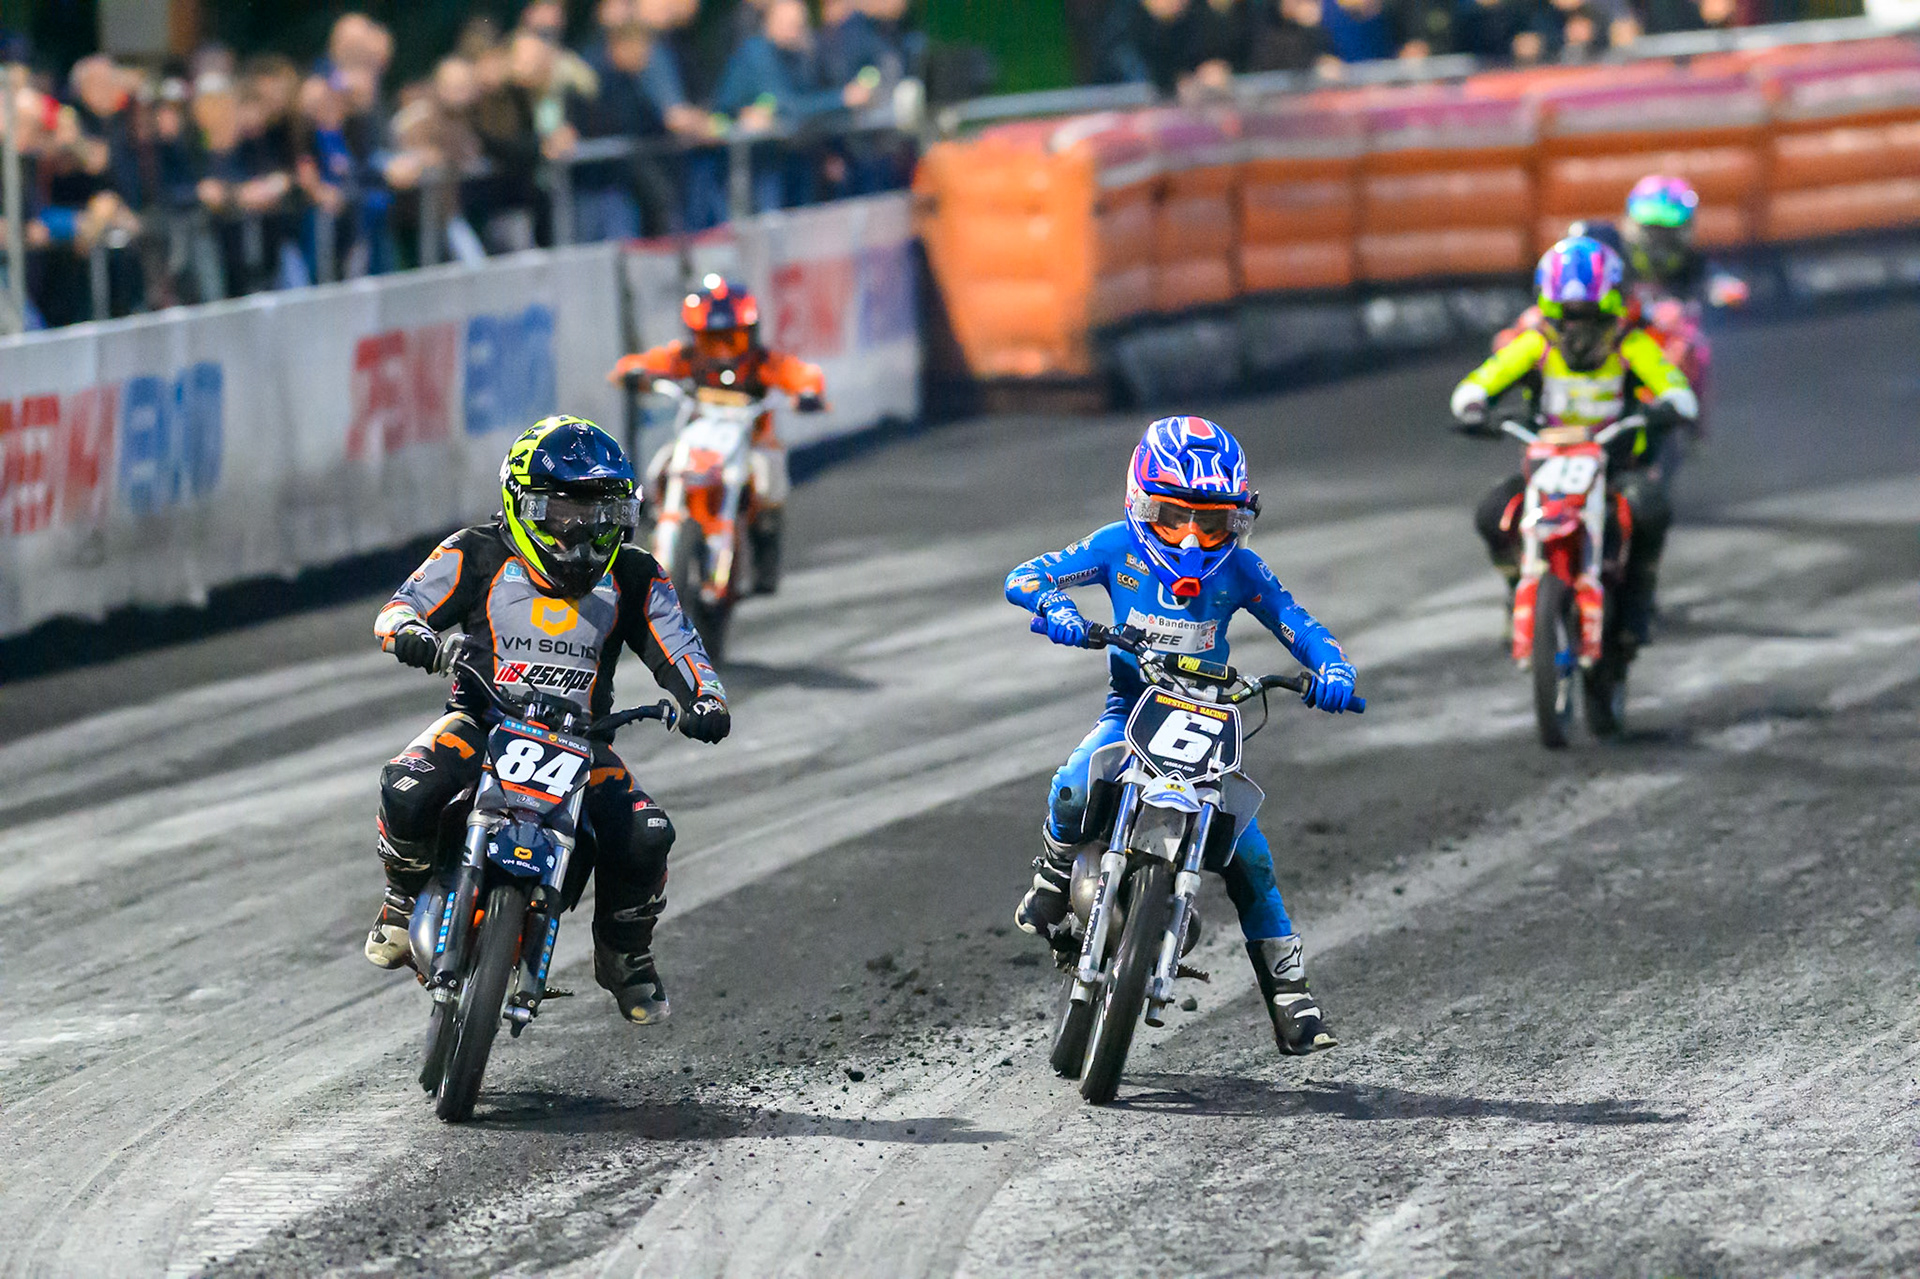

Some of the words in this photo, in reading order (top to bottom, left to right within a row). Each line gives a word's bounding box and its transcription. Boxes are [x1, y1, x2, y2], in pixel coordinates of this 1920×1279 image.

[1531, 455, 1598, 494] 48
[501, 636, 532, 651] VM
[538, 638, 598, 660] SOLID
[1156, 694, 1197, 712] HOFSTEDE
[1199, 706, 1229, 721] RACING
[1147, 709, 1224, 764] 6
[495, 738, 585, 798] 84
